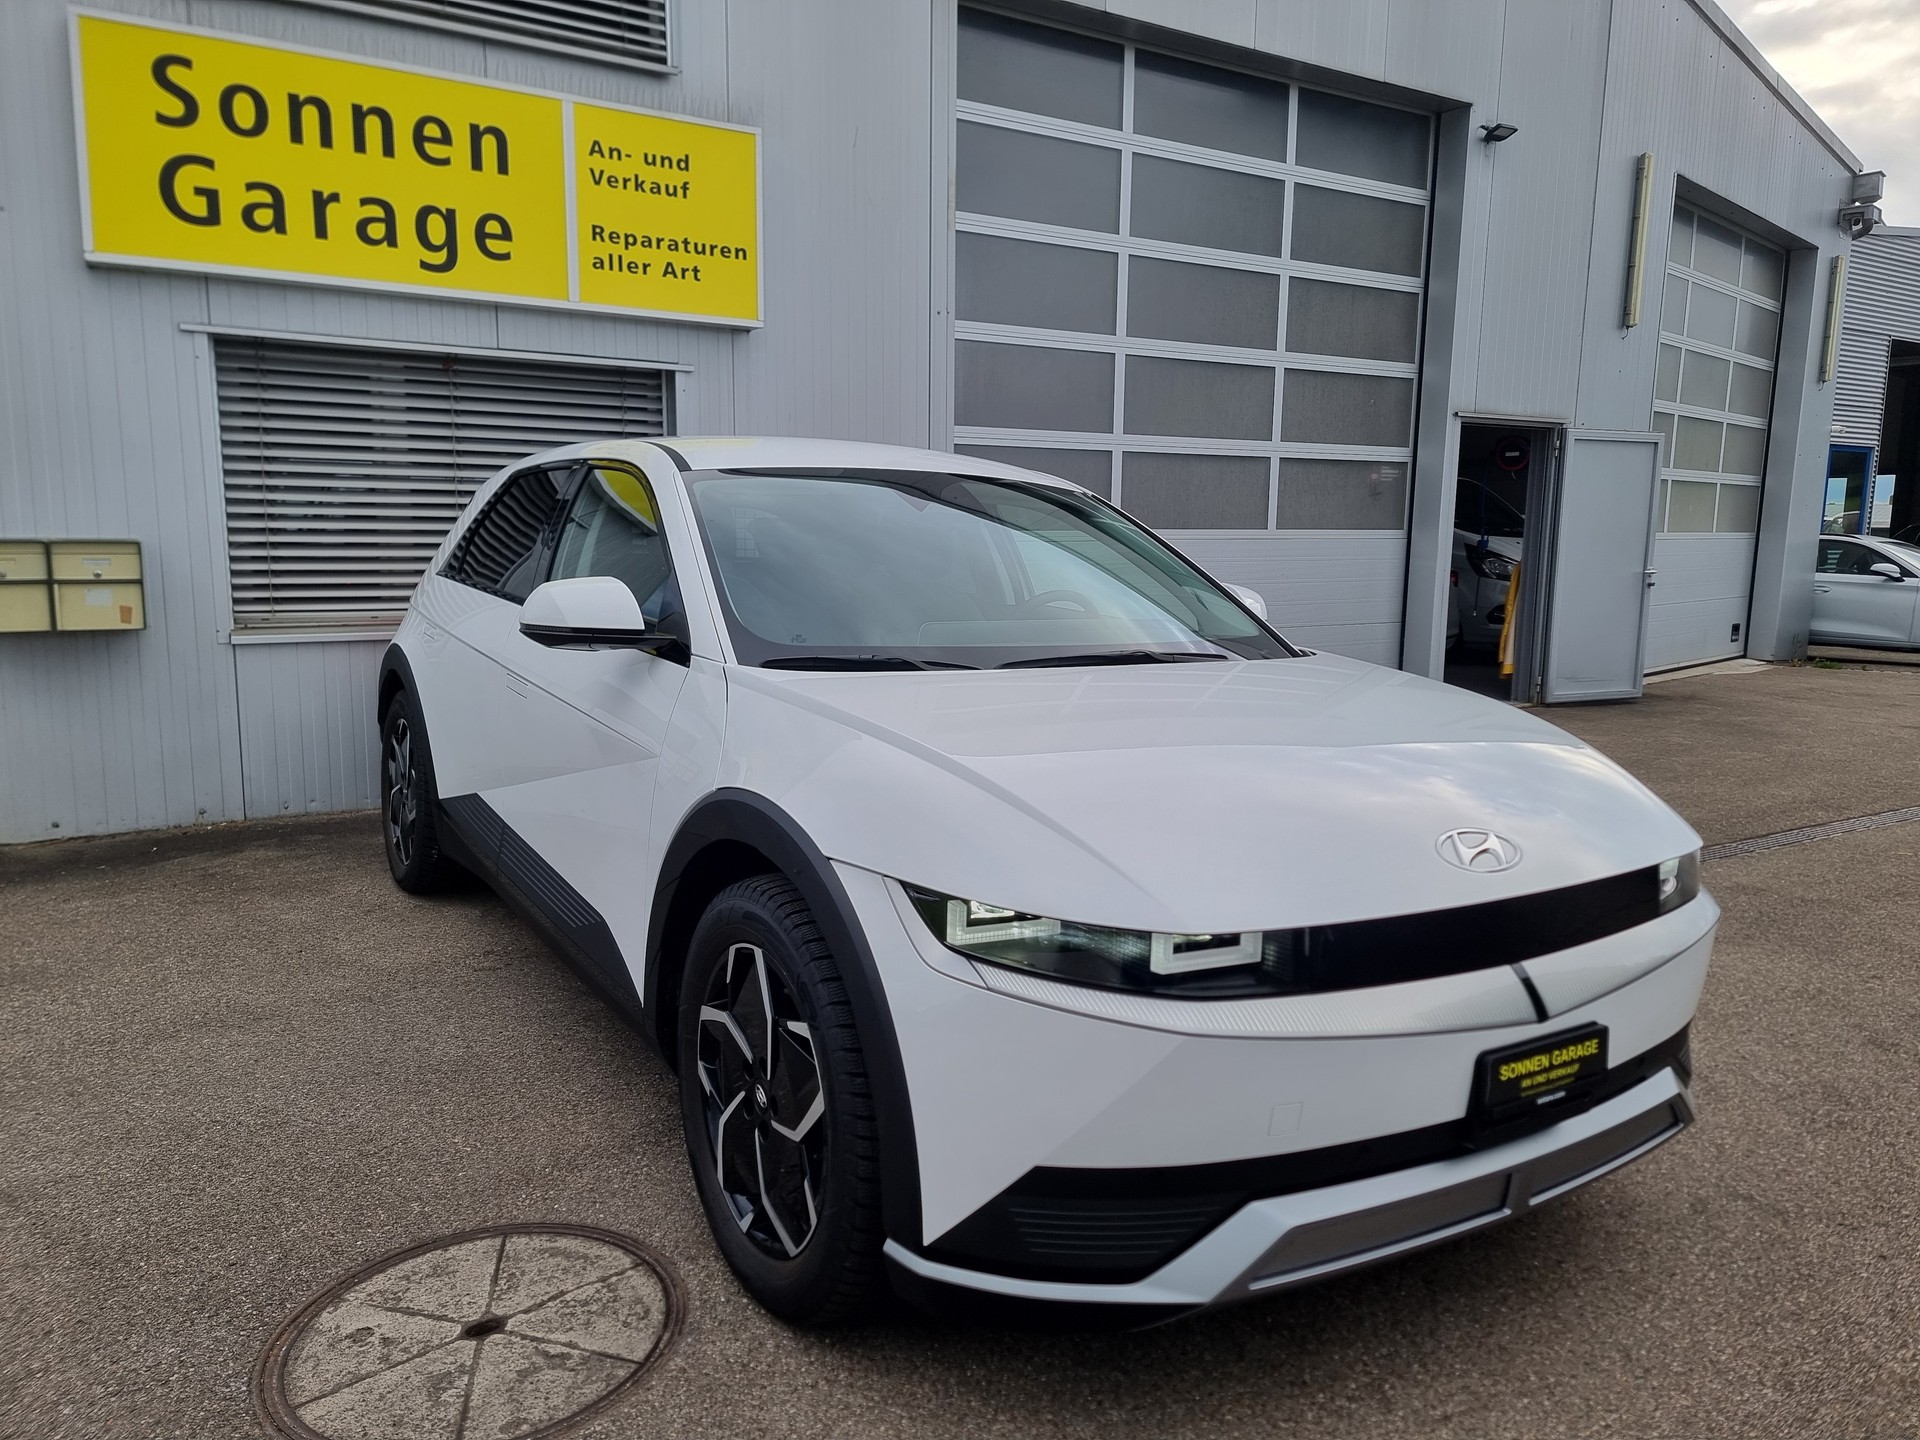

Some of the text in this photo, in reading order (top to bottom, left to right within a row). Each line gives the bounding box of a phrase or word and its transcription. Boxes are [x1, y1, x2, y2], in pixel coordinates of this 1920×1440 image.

[151, 54, 510, 176] Sonnen
[588, 139, 690, 172] An- und
[588, 167, 690, 199] Verkauf
[157, 154, 514, 274] Garage
[591, 224, 748, 261] Reparaturen
[592, 253, 701, 282] aller Art
[1499, 1039, 1600, 1081] SONNEN GARAGE
